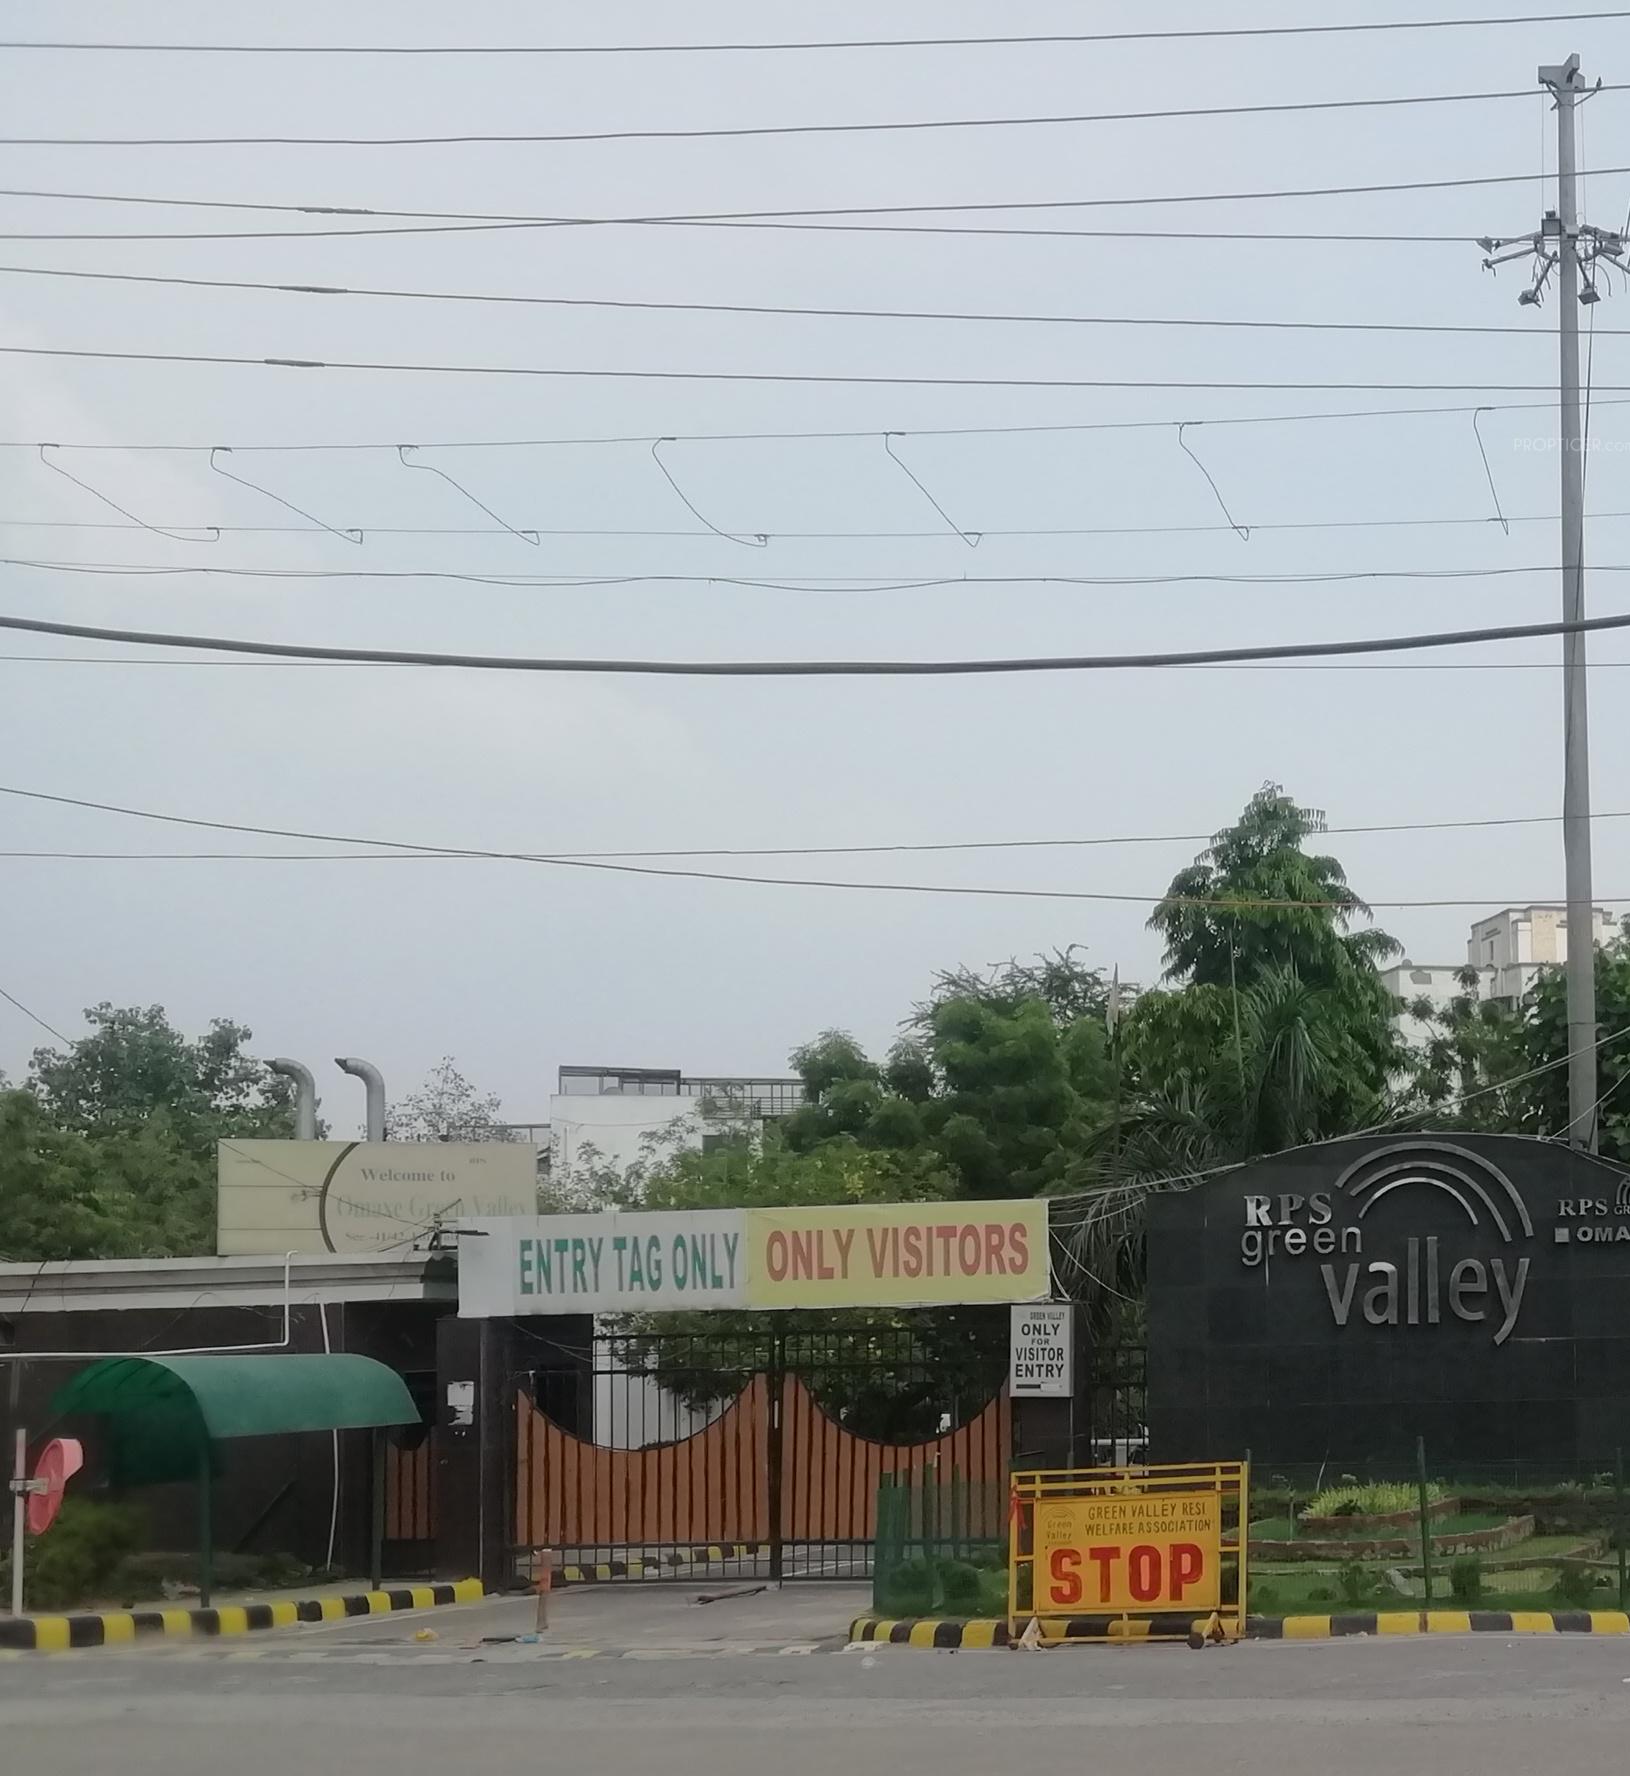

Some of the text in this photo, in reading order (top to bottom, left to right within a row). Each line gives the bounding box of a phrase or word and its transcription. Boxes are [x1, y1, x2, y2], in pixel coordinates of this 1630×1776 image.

[361, 1168, 456, 1182] Welcome to
[1244, 1193, 1333, 1226] RPS
[1558, 1199, 1608, 1216] RPS
[766, 1222, 1029, 1282] ONLY VISITORS
[1241, 1225, 1362, 1266] green
[519, 1232, 739, 1295] ENTRY TAG ONLY
[1320, 1236, 1531, 1346] valley
[1021, 1323, 1060, 1336] ONLY
[1015, 1347, 1064, 1361] VISITOR
[1015, 1363, 1064, 1377] ENTRY
[1088, 1505, 1126, 1520] GREEN
[1132, 1502, 1177, 1518] VALLEY
[1085, 1518, 1211, 1536] WELFARE ASSOCIATION
[1050, 1543, 1203, 1605] STOP
